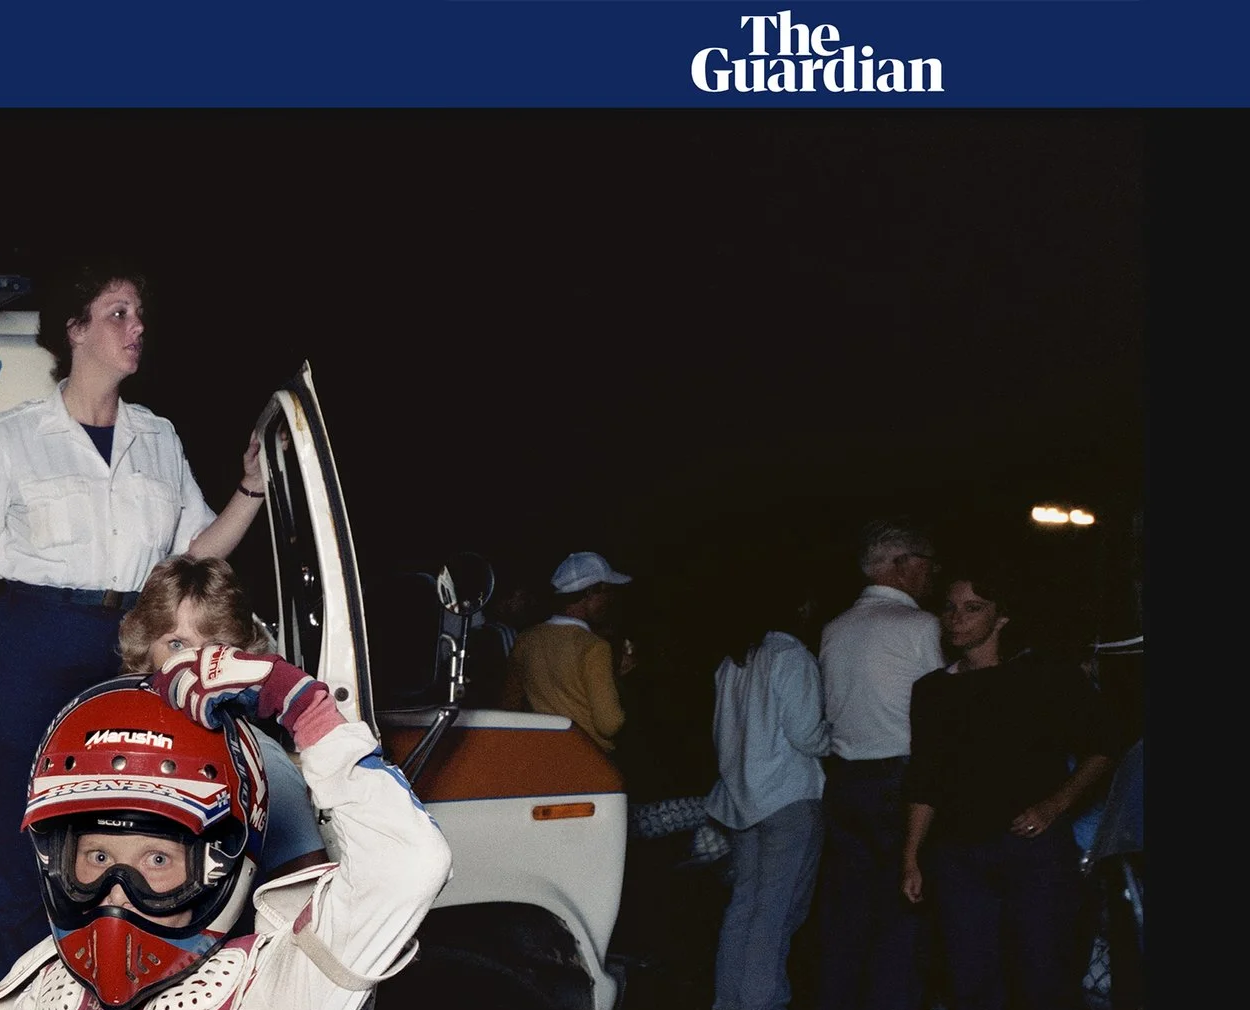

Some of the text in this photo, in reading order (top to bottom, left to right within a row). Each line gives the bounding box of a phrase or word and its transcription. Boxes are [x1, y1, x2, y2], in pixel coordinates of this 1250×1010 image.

[85, 729, 173, 749] Marushin
[46, 779, 184, 801] HONDA
[97, 819, 134, 828] SCOTT
